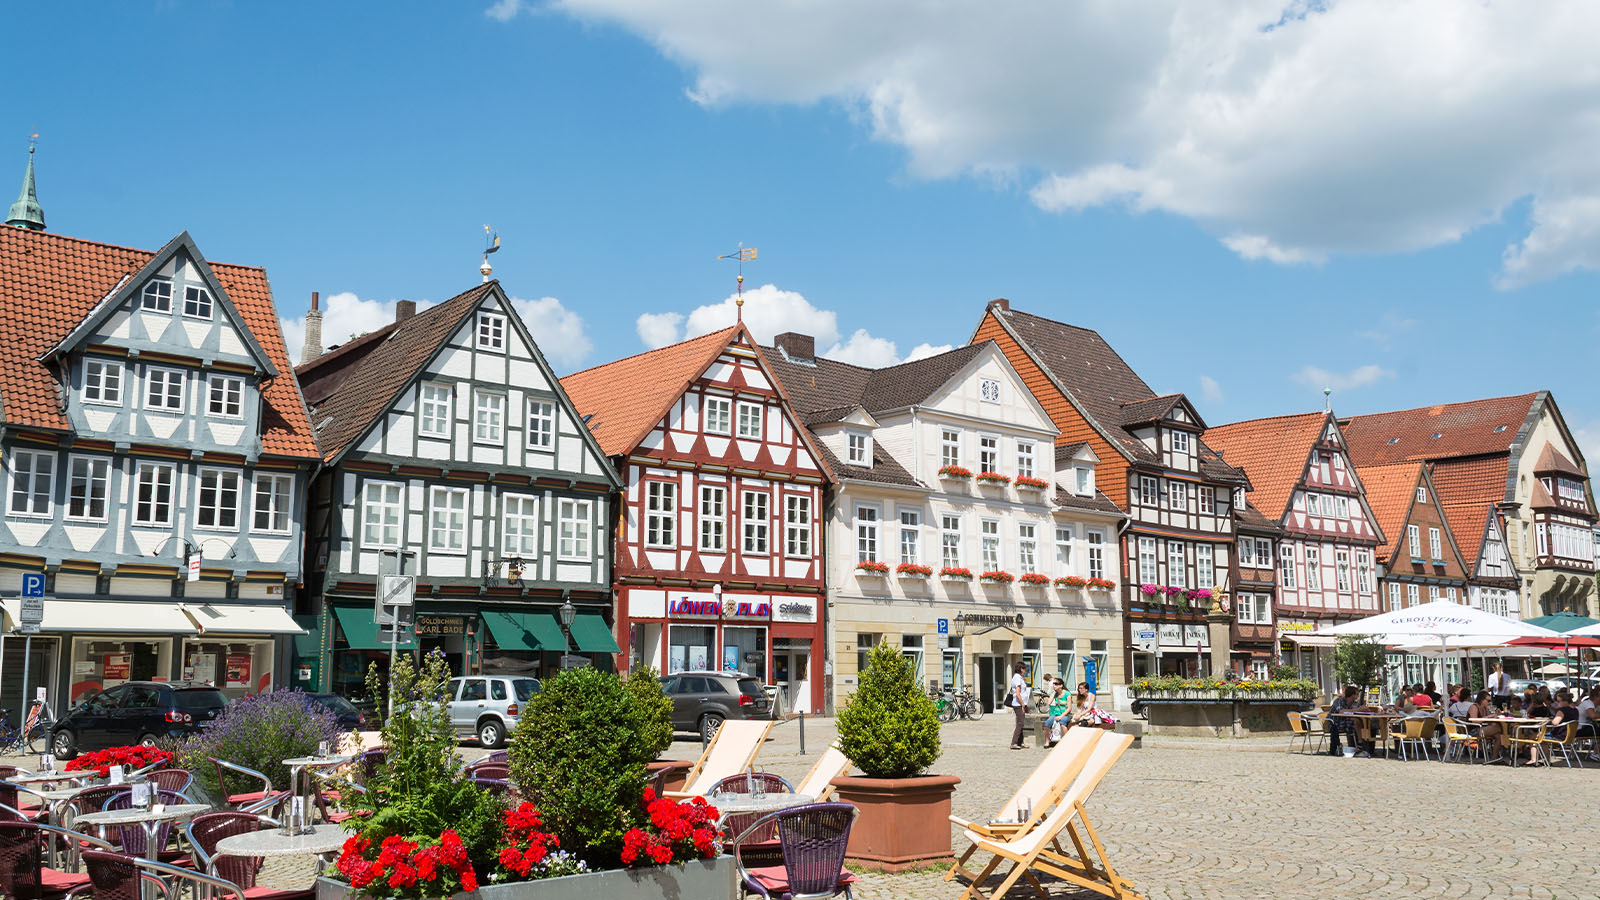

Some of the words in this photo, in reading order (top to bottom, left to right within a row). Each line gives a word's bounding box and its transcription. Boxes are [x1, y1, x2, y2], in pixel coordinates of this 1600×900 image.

[669, 596, 722, 615] LÖWEN
[738, 602, 773, 616] PLAY
[421, 617, 464, 625] GOLDSCHMIED
[1391, 616, 1472, 625] GEROLSTEINER
[421, 626, 442, 634] KARL
[443, 626, 464, 634] BADE
